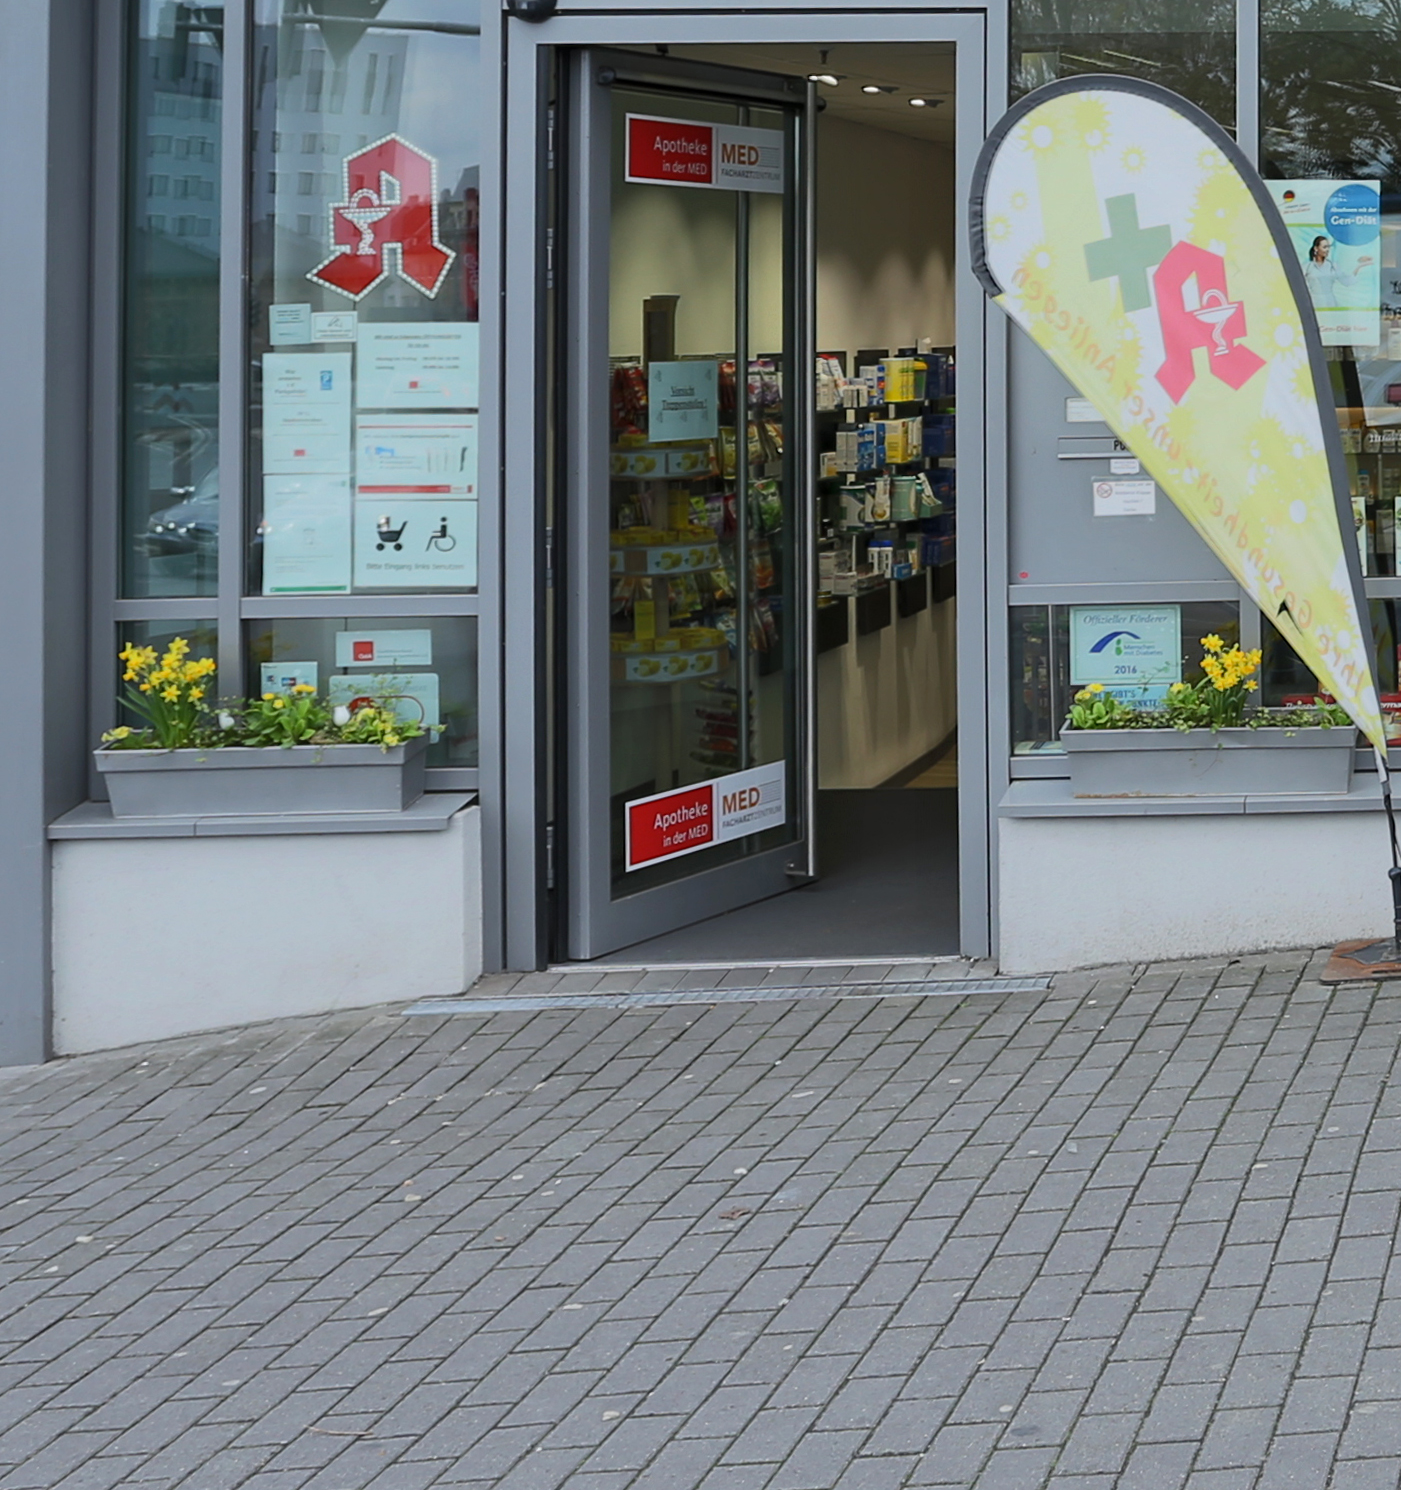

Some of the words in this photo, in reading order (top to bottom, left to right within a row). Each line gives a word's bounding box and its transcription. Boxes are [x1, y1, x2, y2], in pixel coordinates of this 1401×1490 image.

[653, 135, 708, 156] Apotheke
[721, 143, 760, 166] MED
[662, 160, 671, 172] in
[672, 161, 686, 174] der
[687, 162, 708, 176] MED
[1330, 215, 1378, 225] Gen-Diät
[366, 562, 383, 571] Bitte
[384, 562, 413, 572] Eingang
[1083, 614, 1127, 625] Offizieller
[1129, 613, 1168, 624] Förderer
[1114, 665, 1137, 675] 2016
[722, 786, 761, 816] MED
[653, 801, 709, 831] Apotheke
[662, 834, 671, 848] in
[672, 829, 686, 845] der
[688, 824, 709, 841] MED
